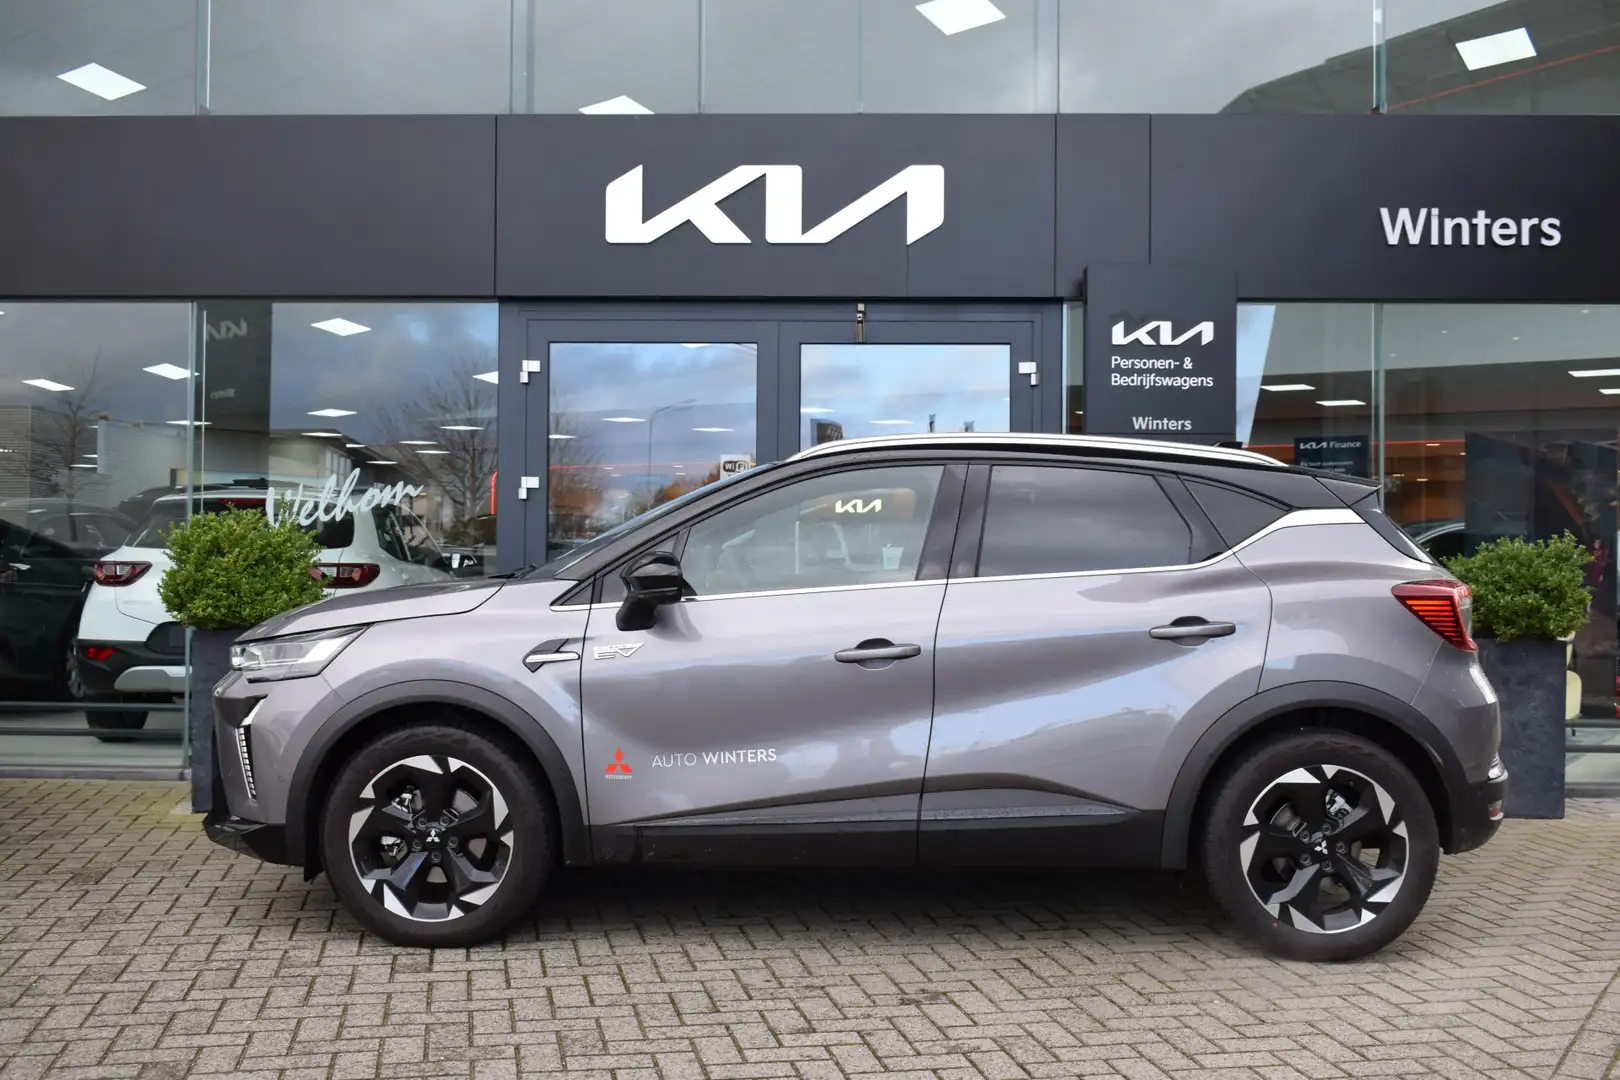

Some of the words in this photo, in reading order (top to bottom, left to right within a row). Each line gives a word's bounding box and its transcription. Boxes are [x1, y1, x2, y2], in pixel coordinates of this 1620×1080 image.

[605, 164, 945, 246] KIA
[1379, 207, 1562, 246] Winters
[1111, 320, 1214, 346] KIA
[1111, 356, 1180, 369] Personen-
[1183, 357, 1193, 369] &
[1111, 373, 1214, 390] Bedrijfswagens
[1132, 416, 1192, 430] Winters
[1299, 441, 1328, 450] KIA
[1329, 441, 1362, 449] Finance
[835, 499, 882, 513] KIA
[651, 752, 697, 768] AUTO
[702, 748, 777, 764] WINTERS
